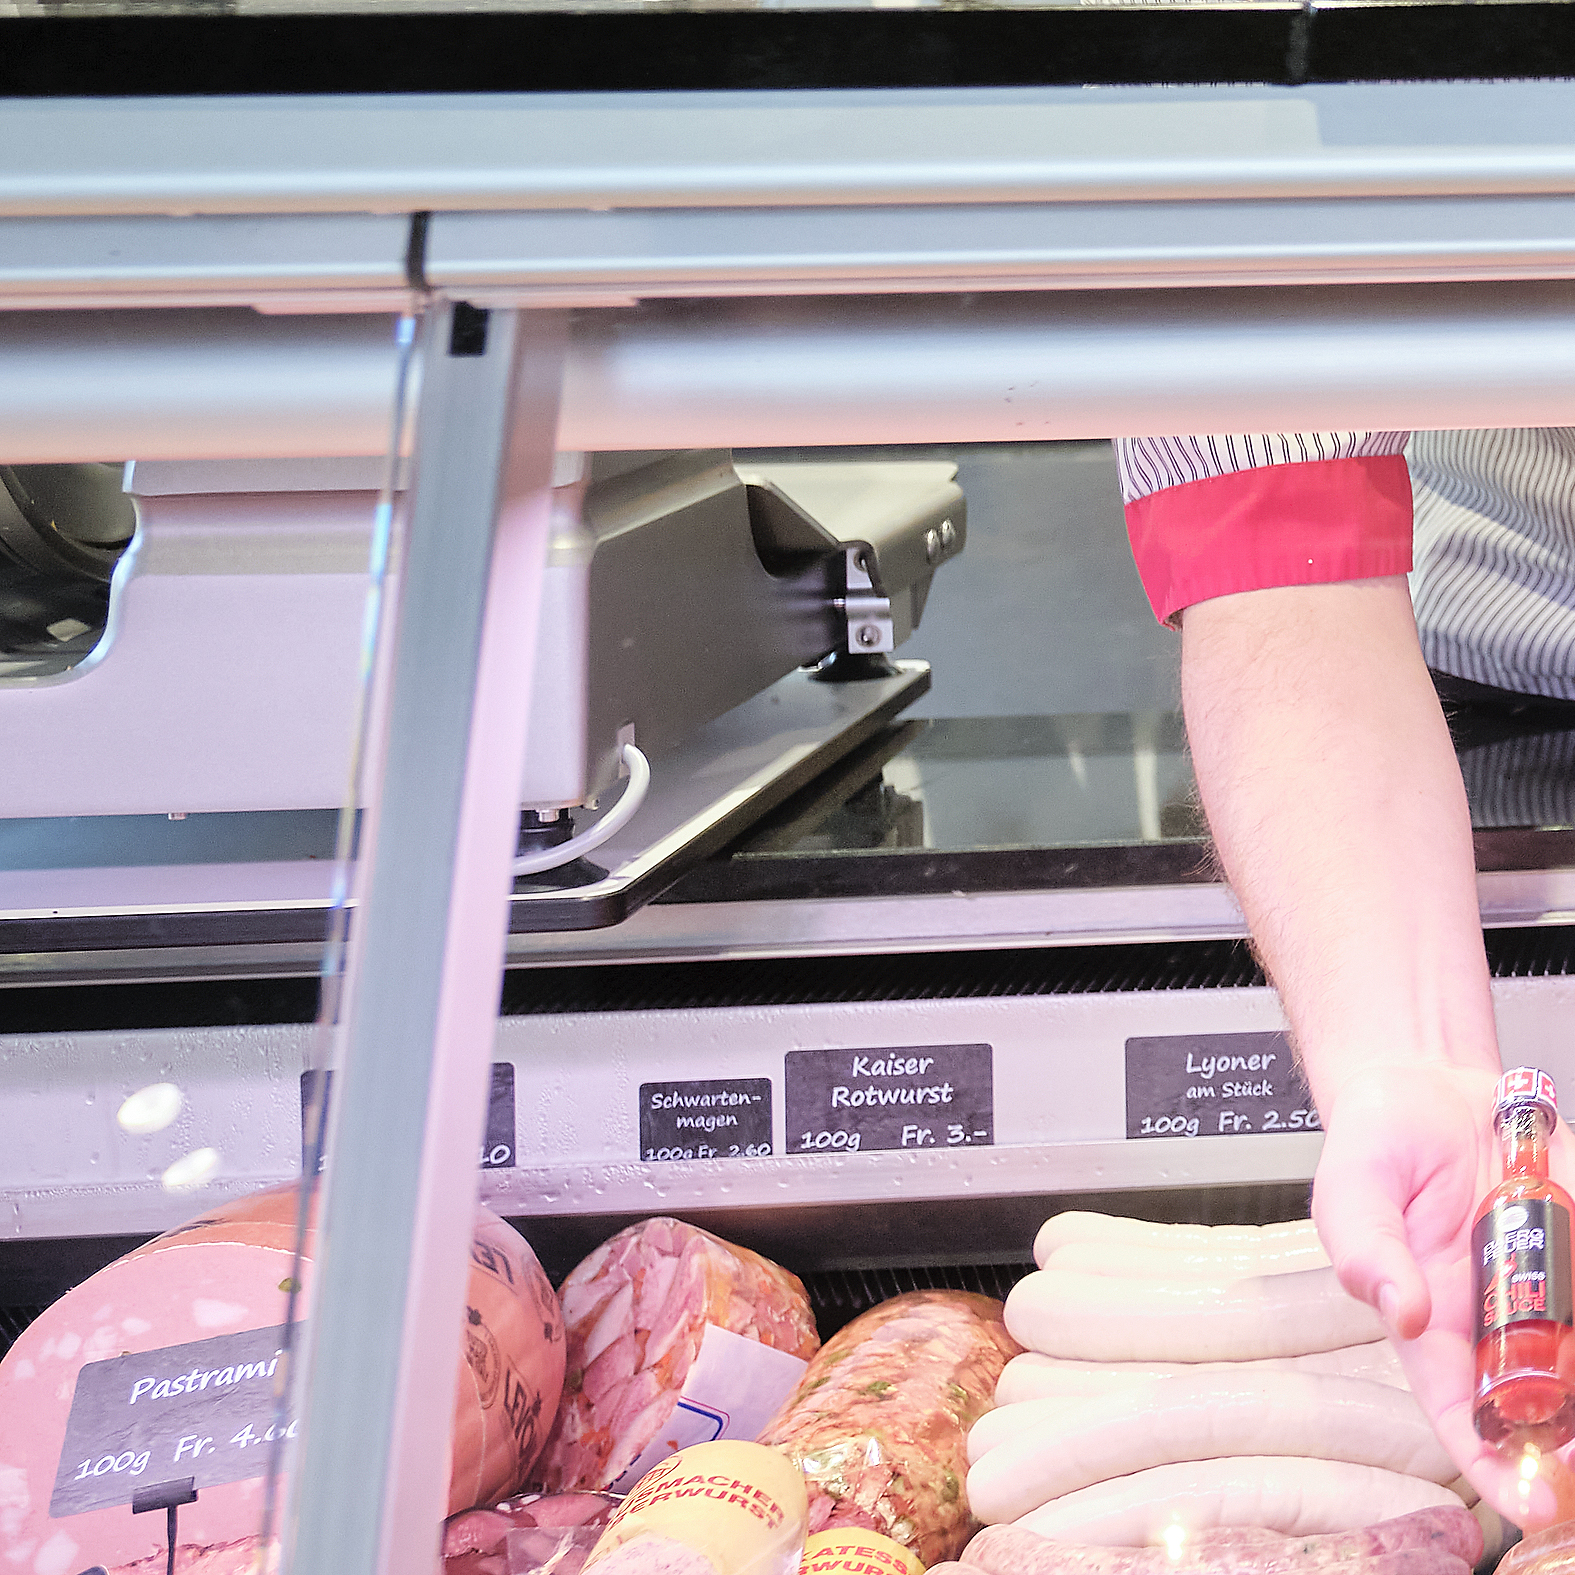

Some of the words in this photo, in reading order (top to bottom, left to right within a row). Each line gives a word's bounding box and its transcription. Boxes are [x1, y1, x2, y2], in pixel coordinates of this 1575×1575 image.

[852, 1053, 934, 1077] Kaiser
[1186, 1051, 1276, 1080] Lyoner
[650, 1091, 762, 1111] Schwarten-
[832, 1082, 954, 1109] Rotwurst
[1186, 1085, 1215, 1099] am
[1221, 1078, 1274, 1099] Stück
[675, 1113, 739, 1132] magen
[1140, 1115, 1200, 1138] 100g
[1218, 1110, 1252, 1132] Fr.
[698, 1144, 718, 1159] Fr
[800, 1129, 863, 1153] 100g
[900, 1125, 936, 1147] Fr.
[1511, 1271, 1546, 1284] SWISS
[1484, 1280, 1546, 1312] CHILI
[129, 1348, 283, 1406] Pastrami
[74, 1450, 151, 1481] 100g
[173, 1434, 216, 1463] Fr.
